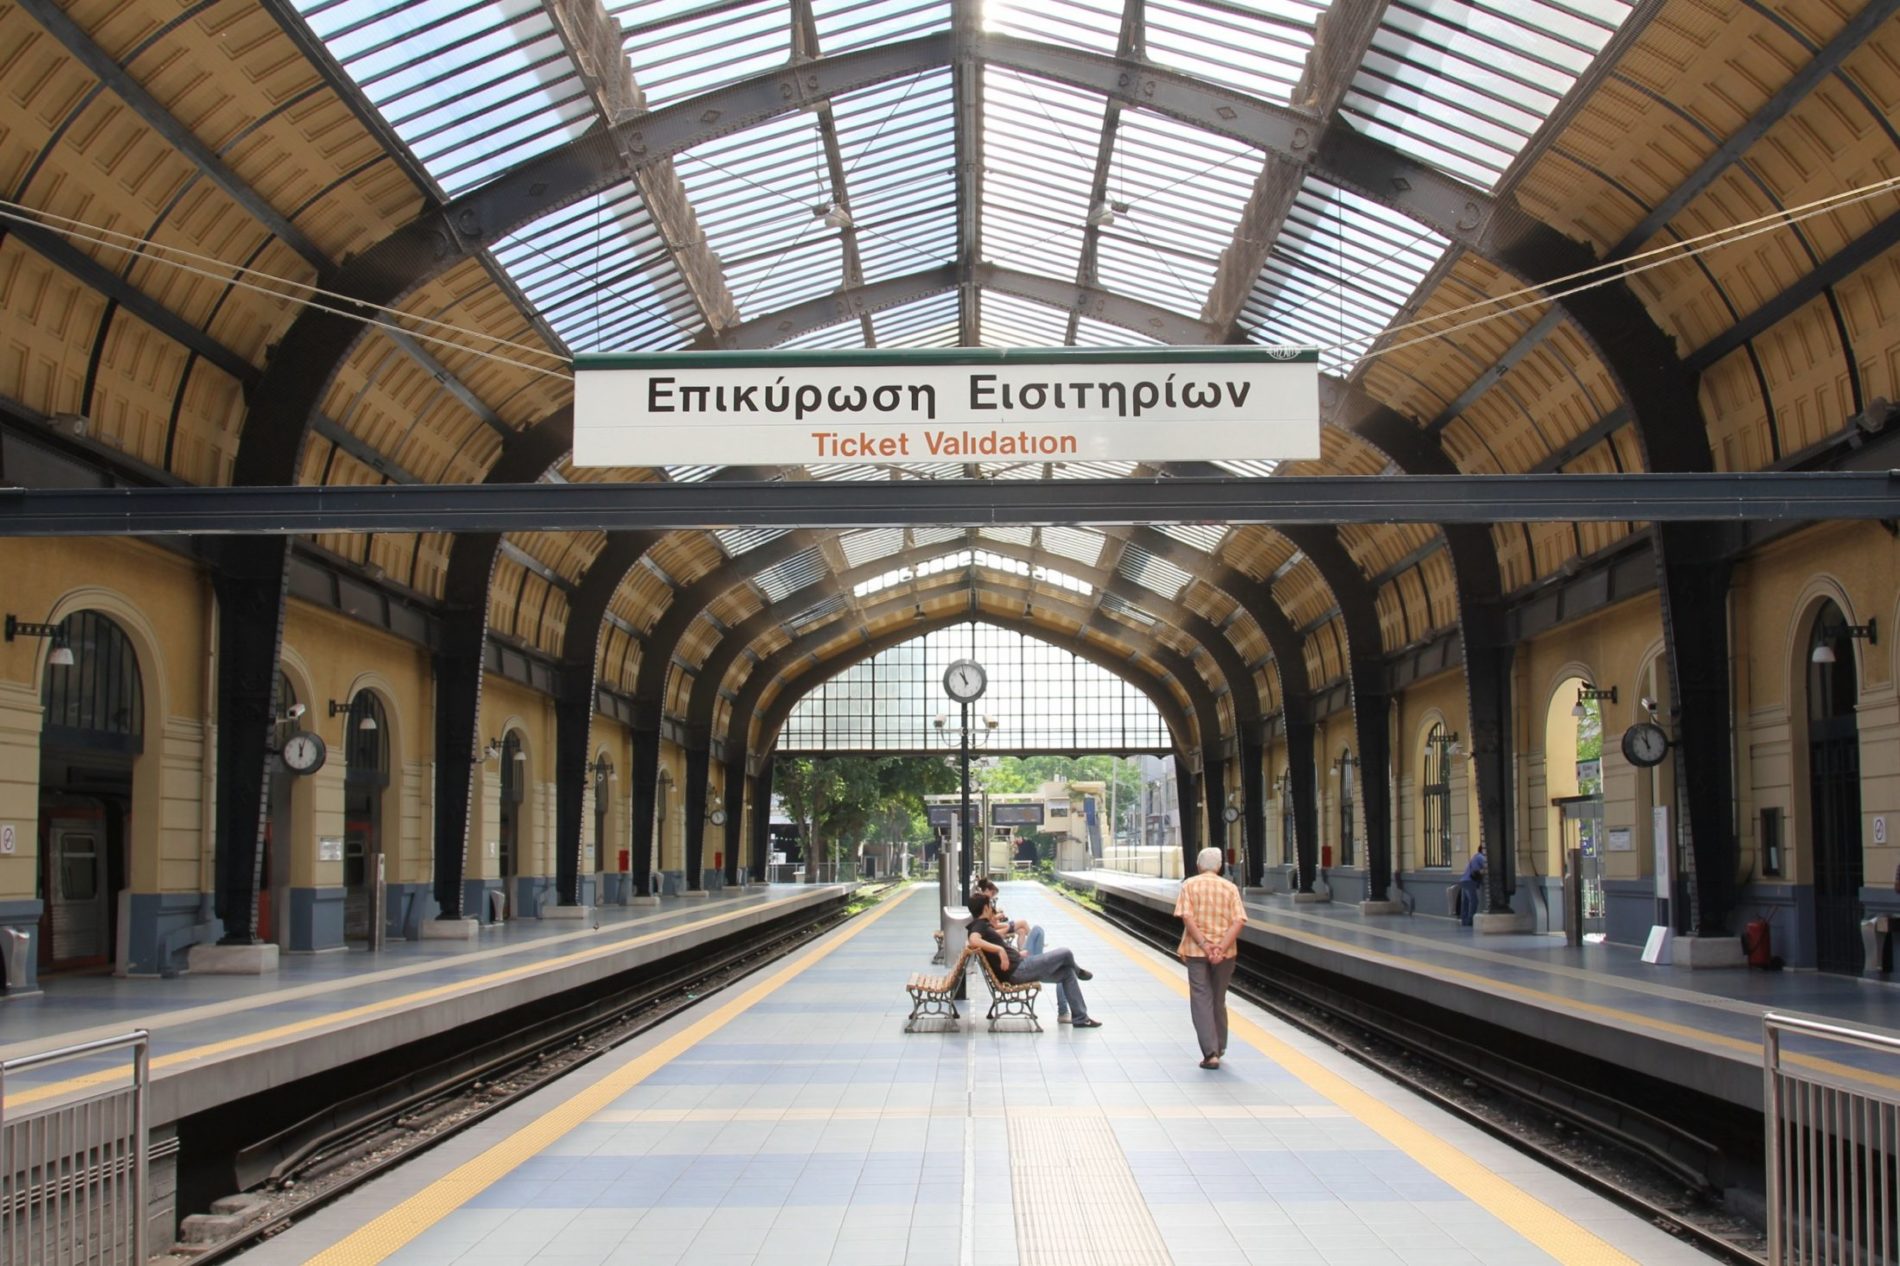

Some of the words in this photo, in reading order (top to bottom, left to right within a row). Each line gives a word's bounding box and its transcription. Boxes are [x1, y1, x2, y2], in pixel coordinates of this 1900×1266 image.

[648, 376, 936, 420] Επικύρωση
[970, 373, 1251, 417] Εισιτηρίων
[811, 432, 909, 457] Ticket
